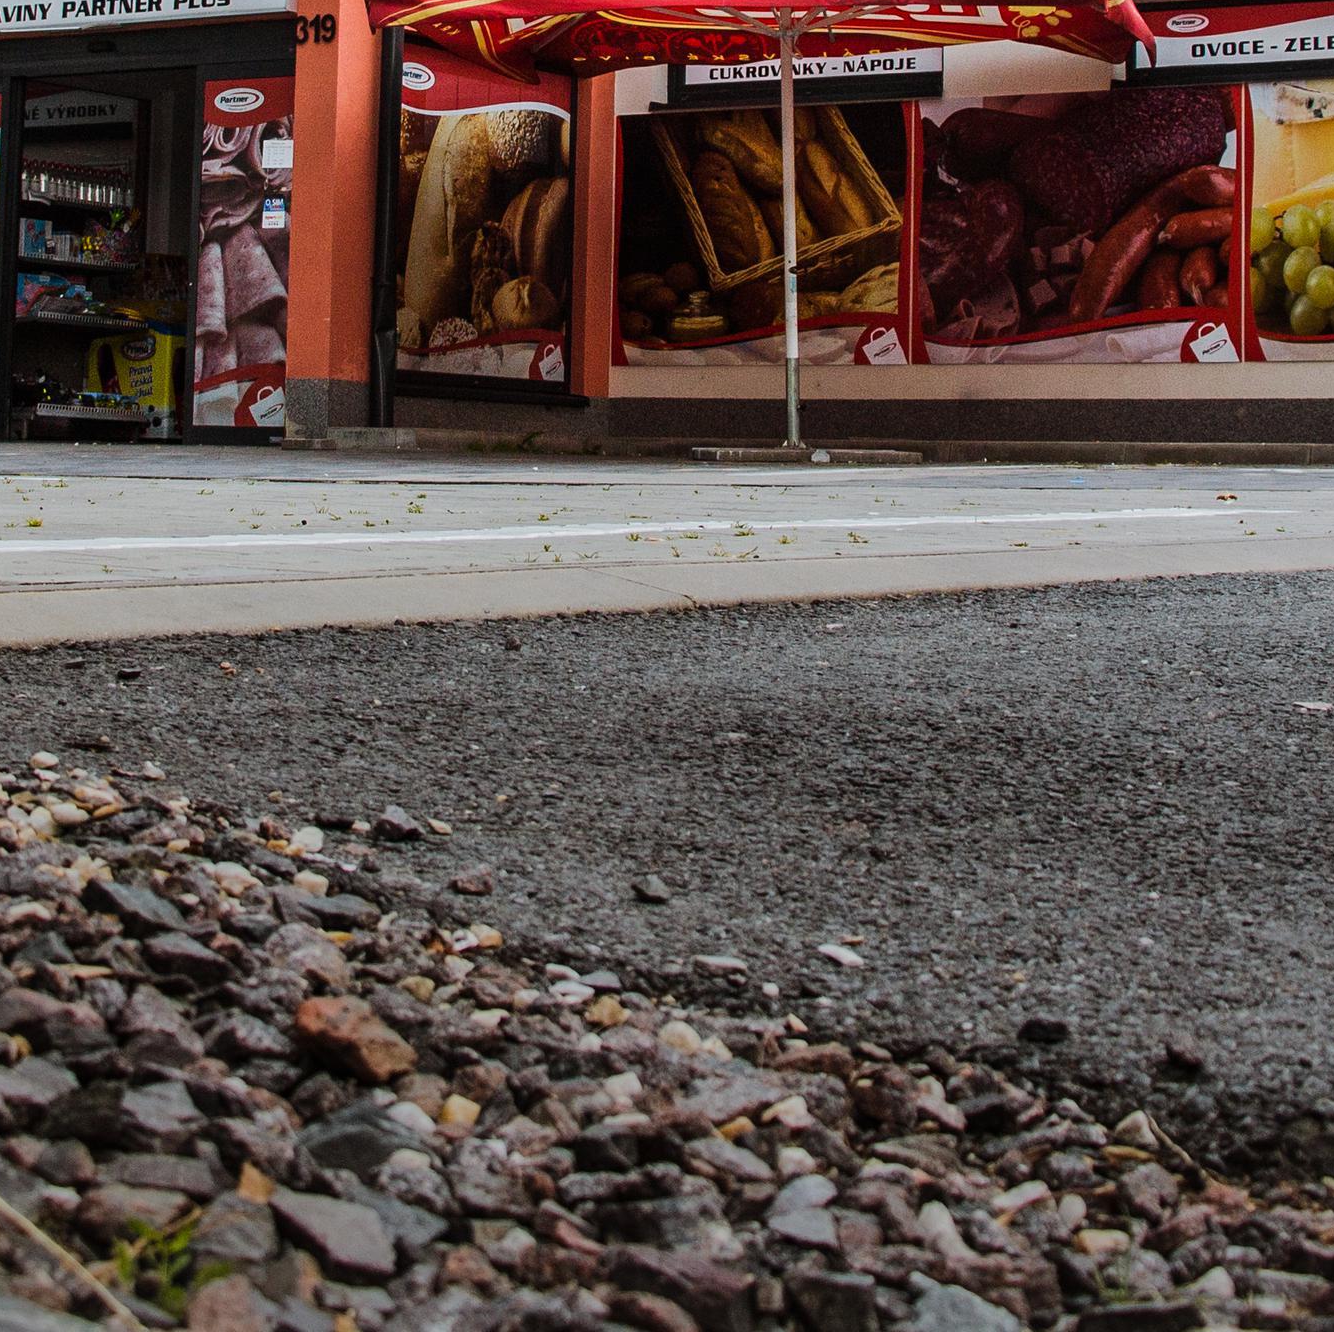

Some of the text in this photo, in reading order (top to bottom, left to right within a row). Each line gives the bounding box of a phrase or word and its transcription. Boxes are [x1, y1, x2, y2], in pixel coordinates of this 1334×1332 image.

[295, 14, 337, 44] 319
[1191, 40, 1264, 57] OVOCE
[403, 70, 423, 80] artner
[709, 61, 827, 81] CUKROVNKY
[843, 57, 917, 73] NÁPOJE
[220, 95, 249, 104] Partner
[47, 104, 118, 119] VÝROBKY
